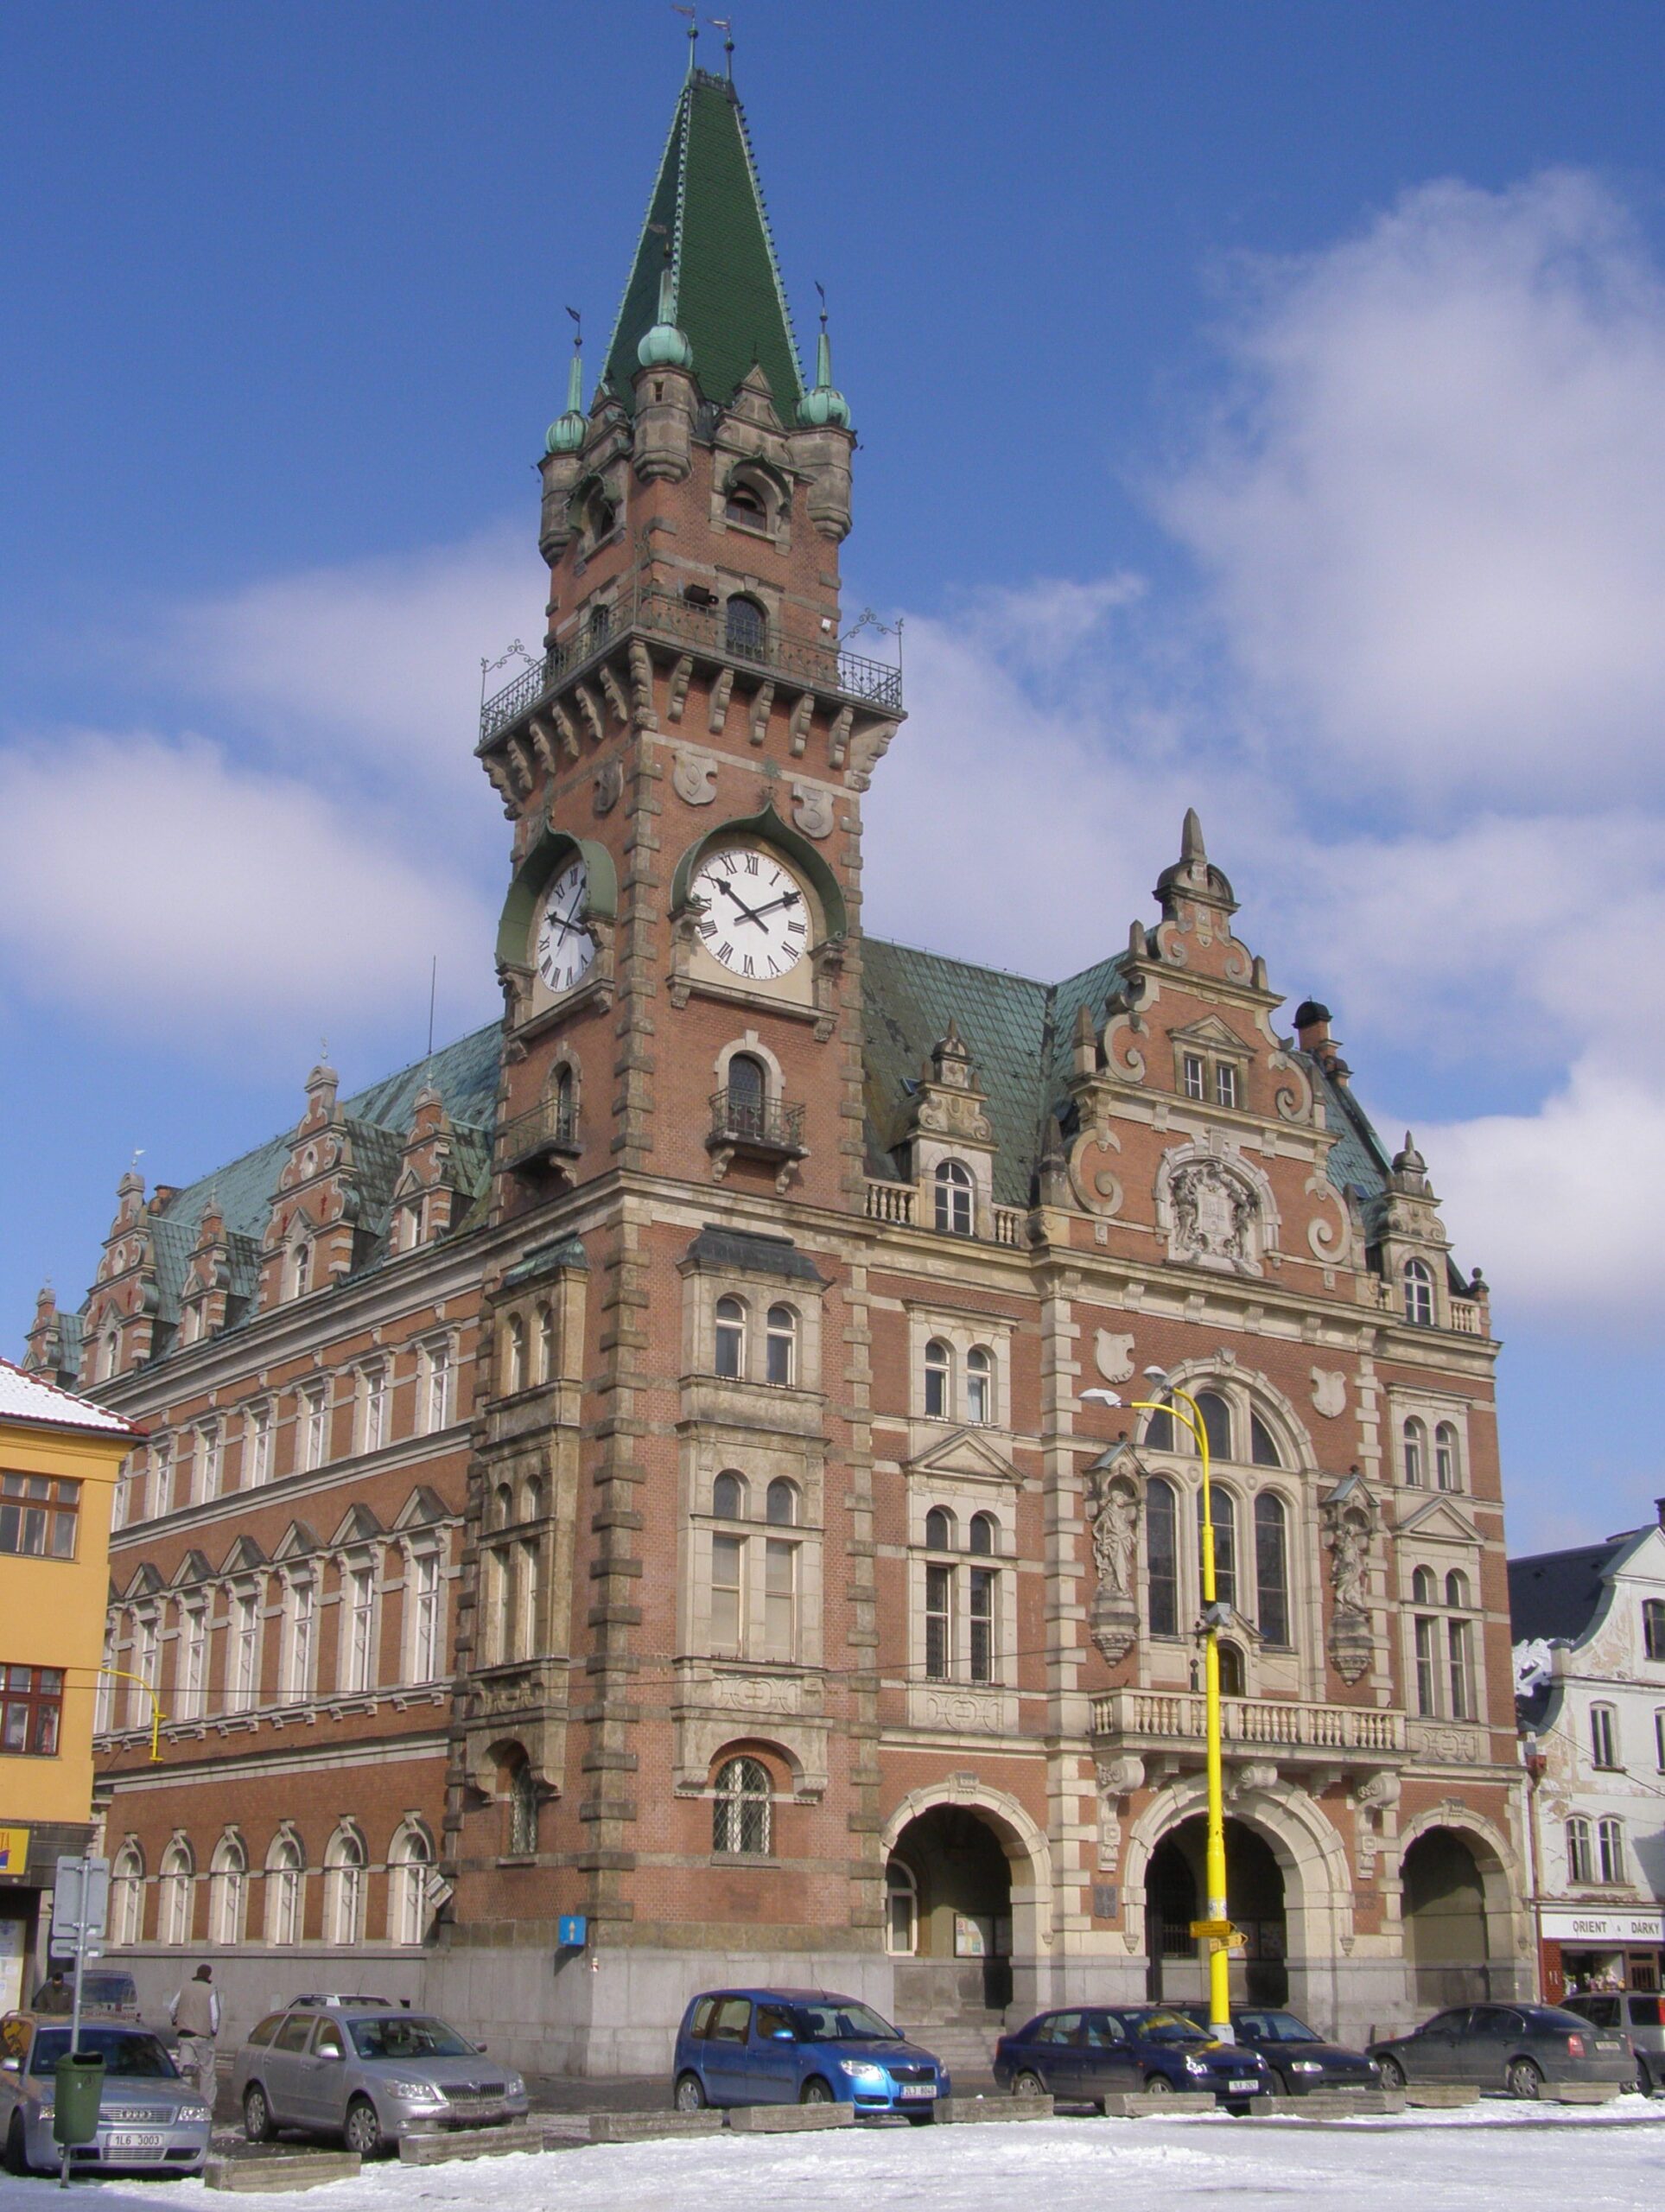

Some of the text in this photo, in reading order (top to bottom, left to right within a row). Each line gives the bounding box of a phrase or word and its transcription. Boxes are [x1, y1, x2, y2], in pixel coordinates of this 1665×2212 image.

[804, 793, 823, 830] 3
[720, 855, 738, 876] XI
[744, 855, 759, 876] XII
[768, 871, 781, 887] I
[788, 920, 805, 935] III
[744, 954, 755, 976] VI
[767, 955, 781, 975] V
[1573, 1920, 1607, 1934] ORIENT
[116, 2135, 131, 2145] 1L6
